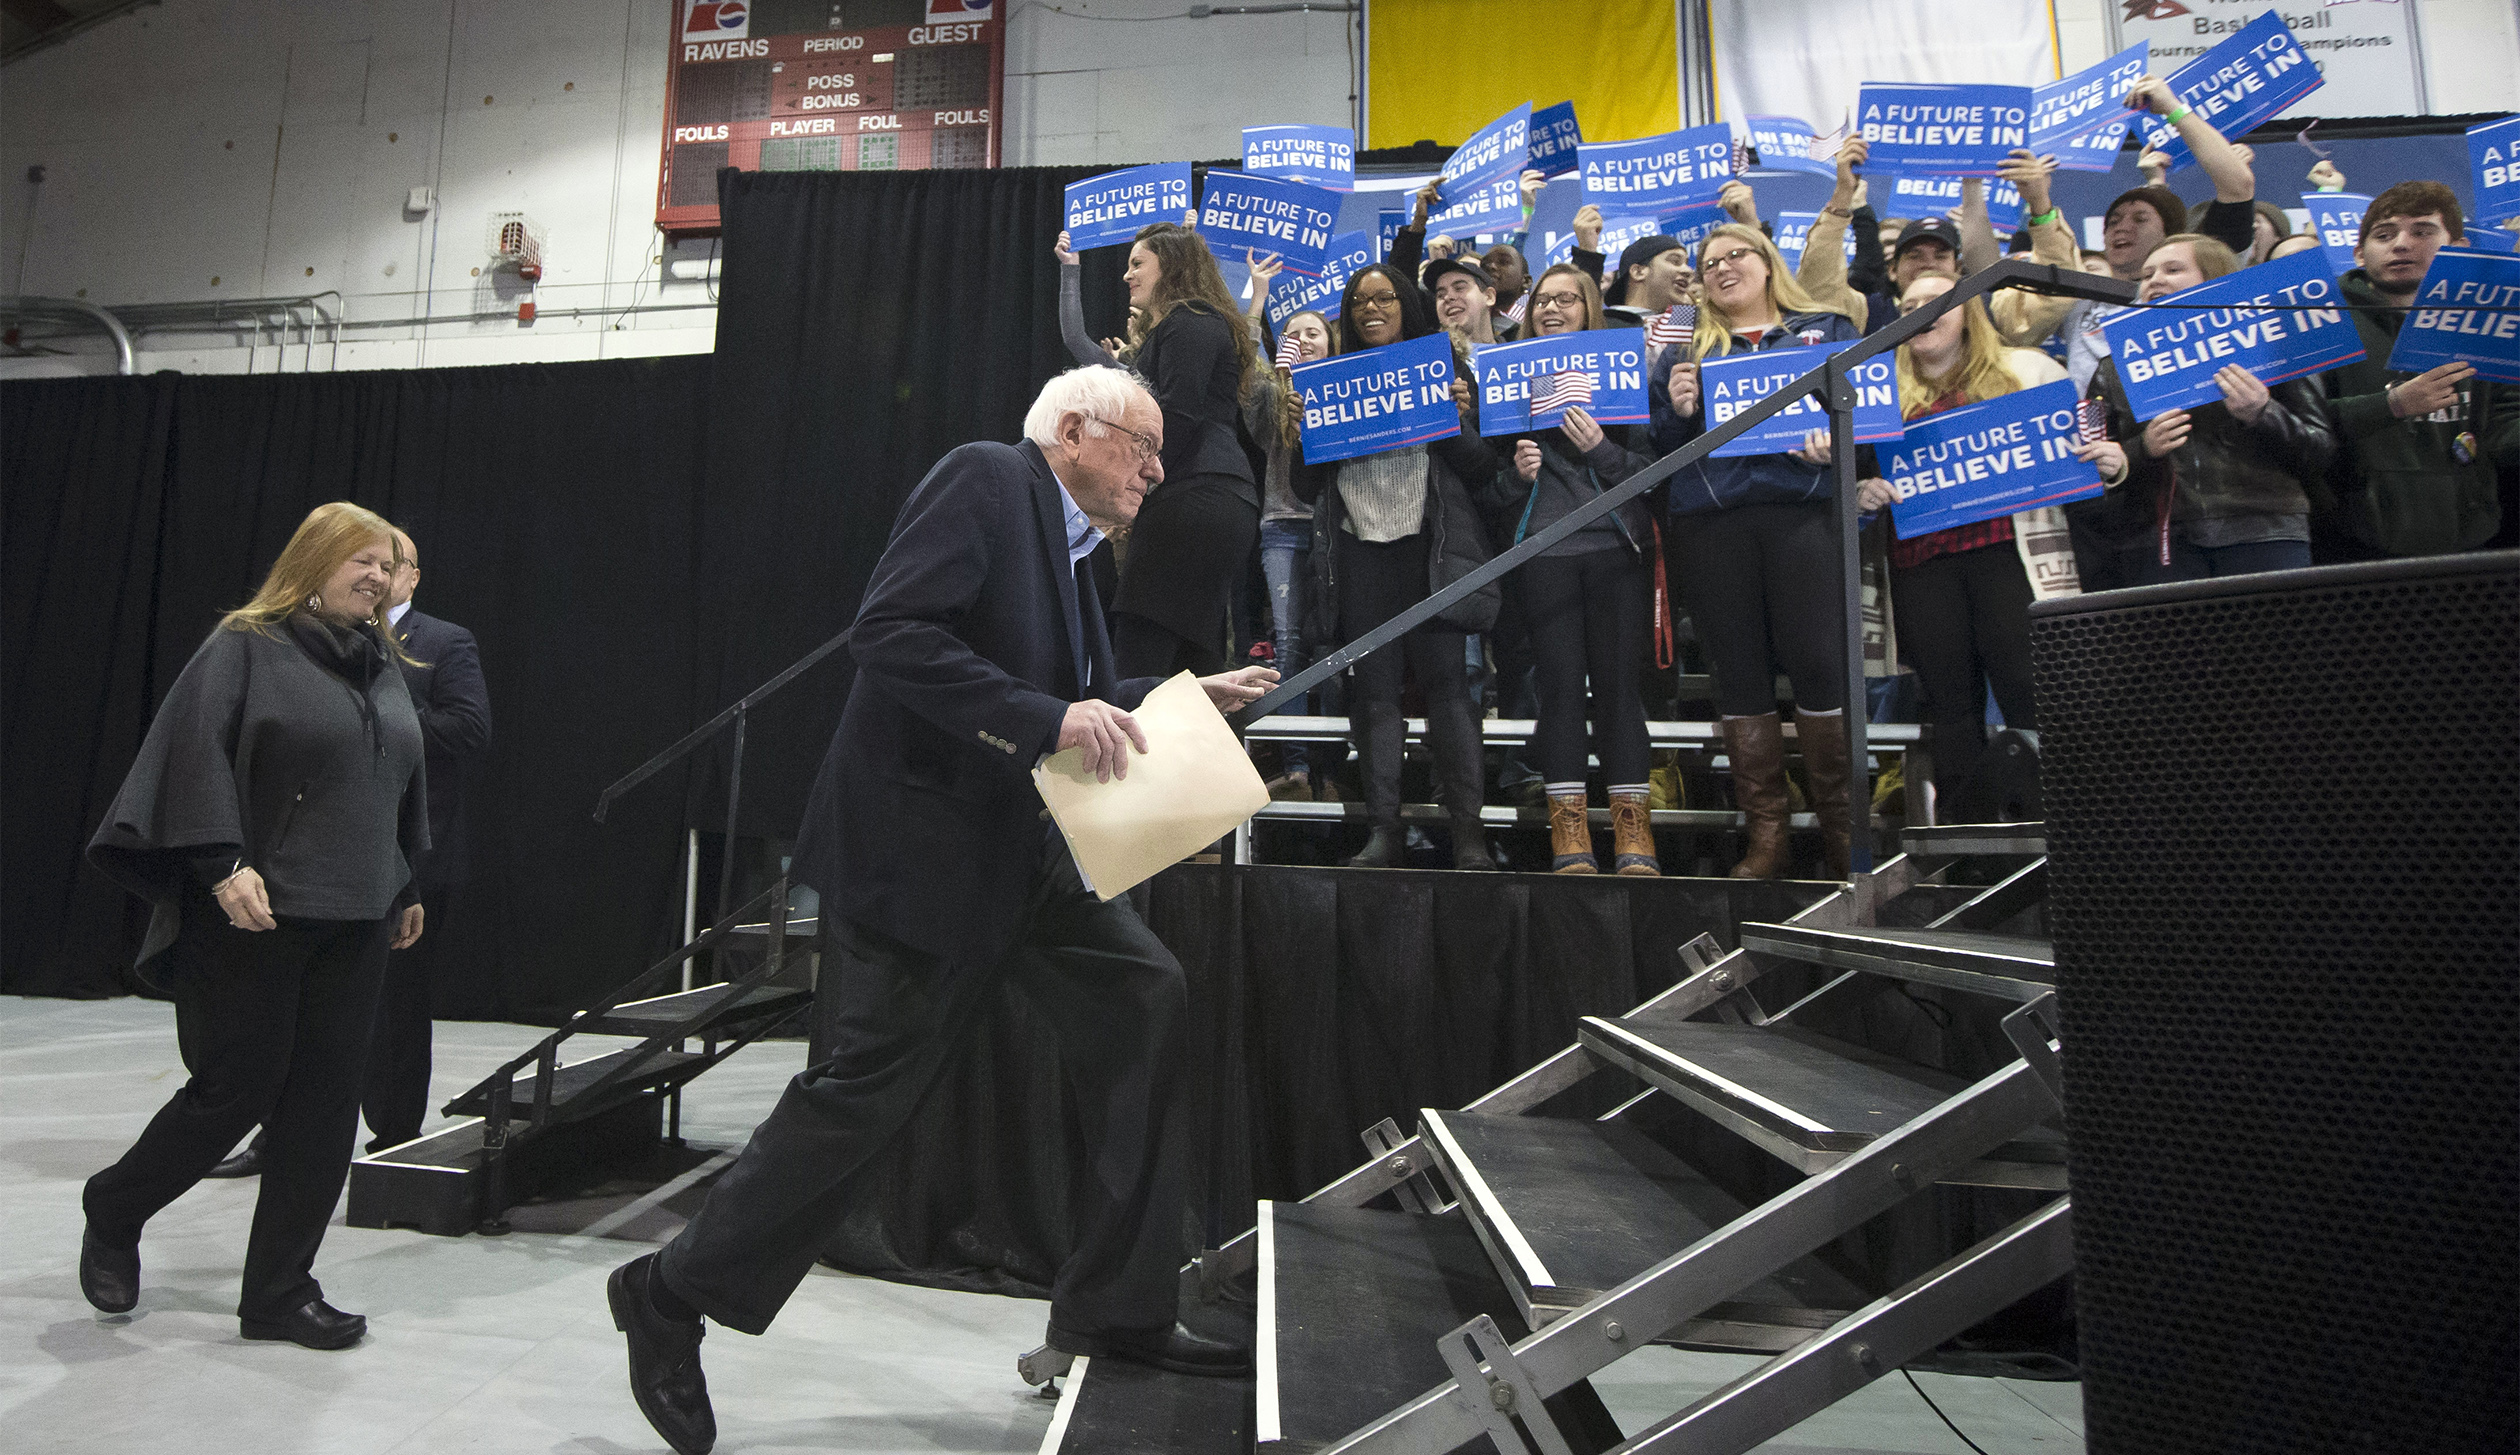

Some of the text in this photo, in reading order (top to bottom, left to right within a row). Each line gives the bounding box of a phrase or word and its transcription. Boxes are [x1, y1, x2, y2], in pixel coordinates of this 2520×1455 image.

[908, 23, 983, 45] GUEST
[2194, 10, 2332, 35] Basball
[684, 39, 769, 62] RAVENS
[804, 36, 864, 53] PERIOD
[2299, 35, 2392, 50] ampions
[2109, 59, 2142, 82] TO
[2264, 47, 2303, 79] IN
[807, 73, 855, 90] POSS
[2142, 116, 2158, 133] A
[2249, 33, 2288, 61] TO
[802, 93, 860, 110] BONUS
[2029, 91, 2104, 134] LIEVE
[2110, 72, 2141, 99] IN
[858, 115, 902, 131] FOUL
[934, 109, 989, 126] FOULS
[1552, 118, 1575, 134] TO
[1864, 104, 2026, 125] A FUTURE TO
[675, 125, 729, 142] FOULS
[770, 118, 835, 136] PLAYER
[1504, 119, 1526, 137] TO
[1862, 122, 1984, 146] BELIEVE
[1991, 126, 2024, 147] IN
[1248, 139, 1350, 156] A FUTURE TO
[1504, 132, 1525, 154] IN
[1558, 132, 1579, 151] IN
[2090, 135, 2120, 151] IN
[1247, 152, 1351, 172] BELIEVE IN
[1587, 142, 1727, 175] A FUTURE TO
[2482, 146, 2503, 165] A
[1492, 179, 1516, 194] TO
[1587, 159, 1730, 193] BELIEVE IN
[1070, 179, 1186, 212] A FUTURE TO
[1495, 193, 1518, 210] IN
[1896, 178, 1992, 202] BELIEE
[1995, 188, 2021, 207] IN
[1069, 194, 1187, 228] BELIEVE IN
[1208, 191, 1332, 228] A FUTURE TO
[2321, 212, 2338, 227] A
[1203, 208, 1328, 250] BELIEVE IN
[1630, 221, 1656, 235] TO
[1268, 294, 1278, 307] A
[1342, 250, 1368, 268] TO
[1270, 275, 1346, 324] BELIEVE
[2425, 279, 2520, 307] A FUT
[2122, 279, 2328, 359] A FUTURE TO
[2127, 317, 2288, 384] BELIEVE
[2293, 301, 2341, 333] IN
[1486, 367, 1500, 383] A
[1507, 353, 1599, 379] FUTURE
[1604, 351, 1638, 367] TO
[1305, 388, 1318, 405] A
[1323, 368, 1410, 401] FUTURE
[1415, 360, 1446, 381] TO
[1486, 371, 1640, 404] BELE IN
[1714, 381, 1731, 399] A
[1851, 363, 1889, 382] TO
[1305, 381, 1450, 429] BELIEVE IN
[1857, 384, 1892, 407] IN
[1348, 426, 1412, 443] BERNIESANDERS.COM
[1892, 409, 2074, 475] A FUTURE TO
[1893, 433, 2082, 500] BELIEVE IN
